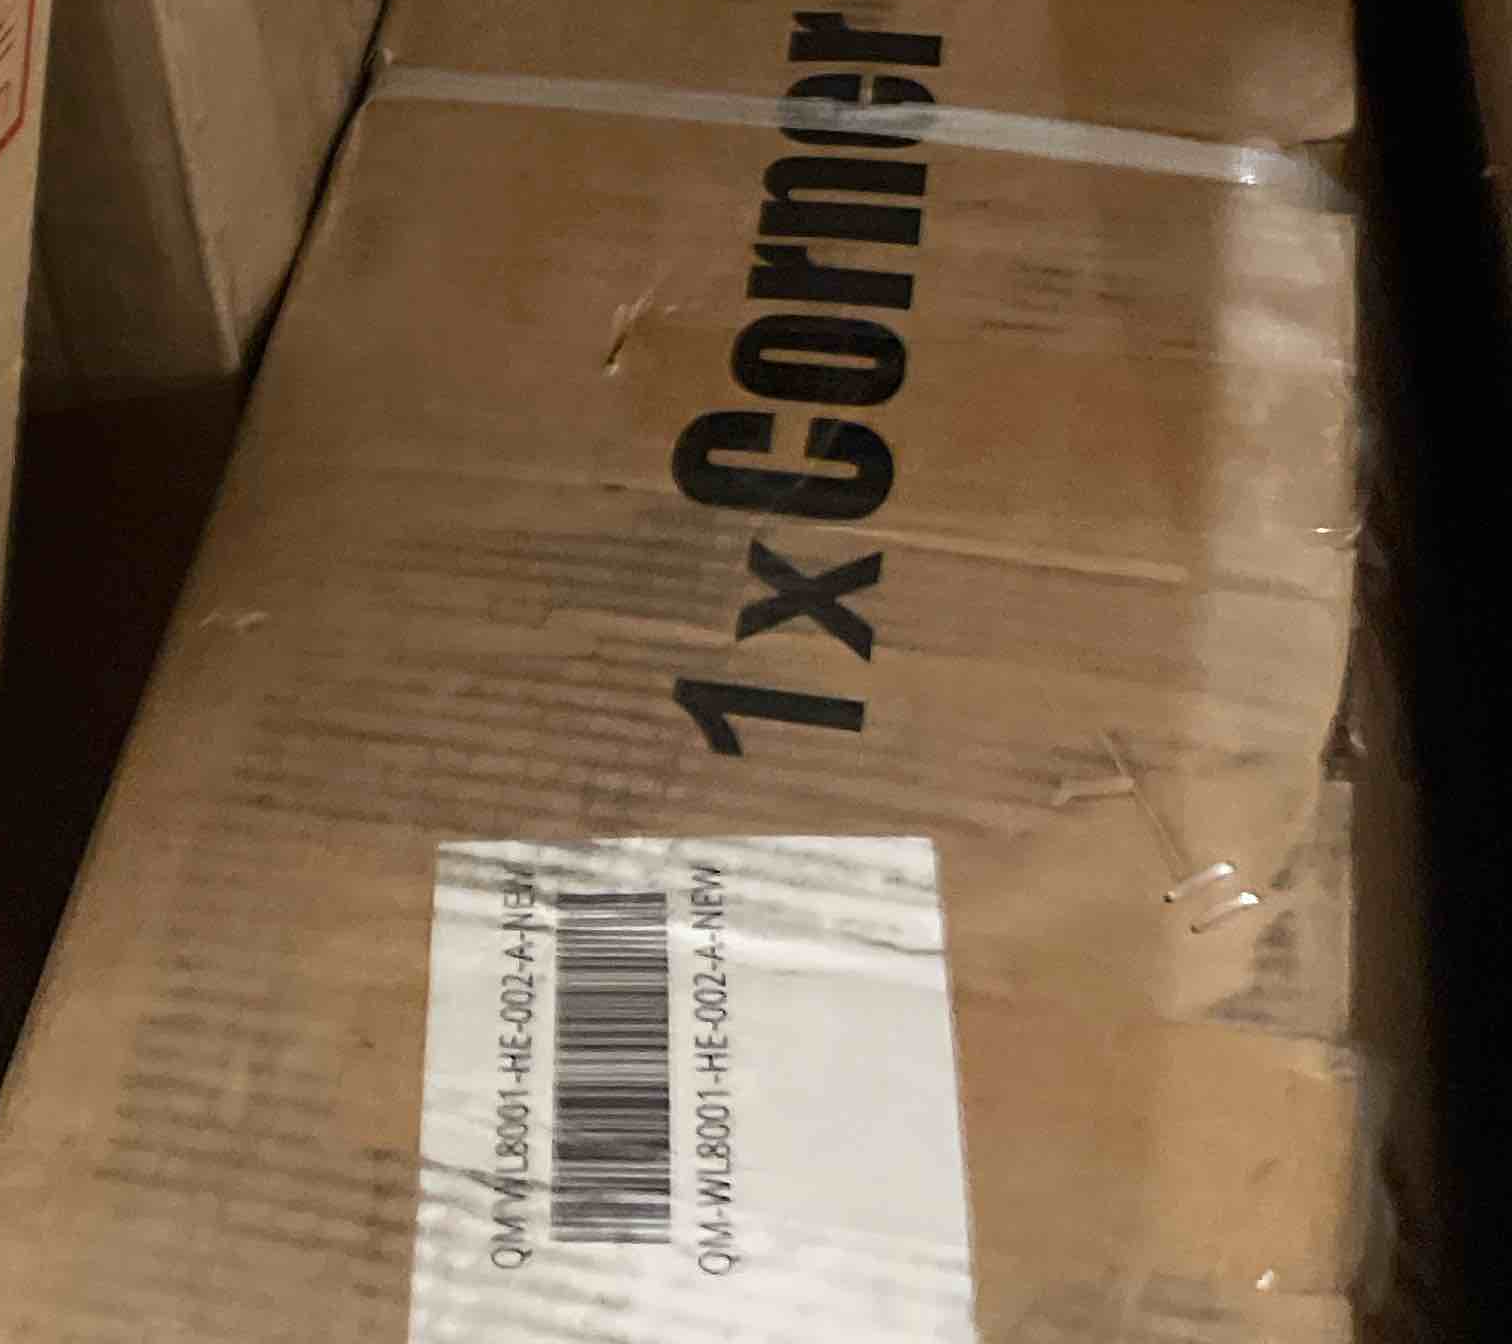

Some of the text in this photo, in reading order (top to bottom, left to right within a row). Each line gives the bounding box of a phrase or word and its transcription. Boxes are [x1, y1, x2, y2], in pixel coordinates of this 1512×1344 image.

[670, 9, 944, 521] Corner
[673, 676, 865, 758] 1
[734, 538, 884, 662] x
[690, 863, 740, 1275] QM-WL8001-HE-002-A-NEW
